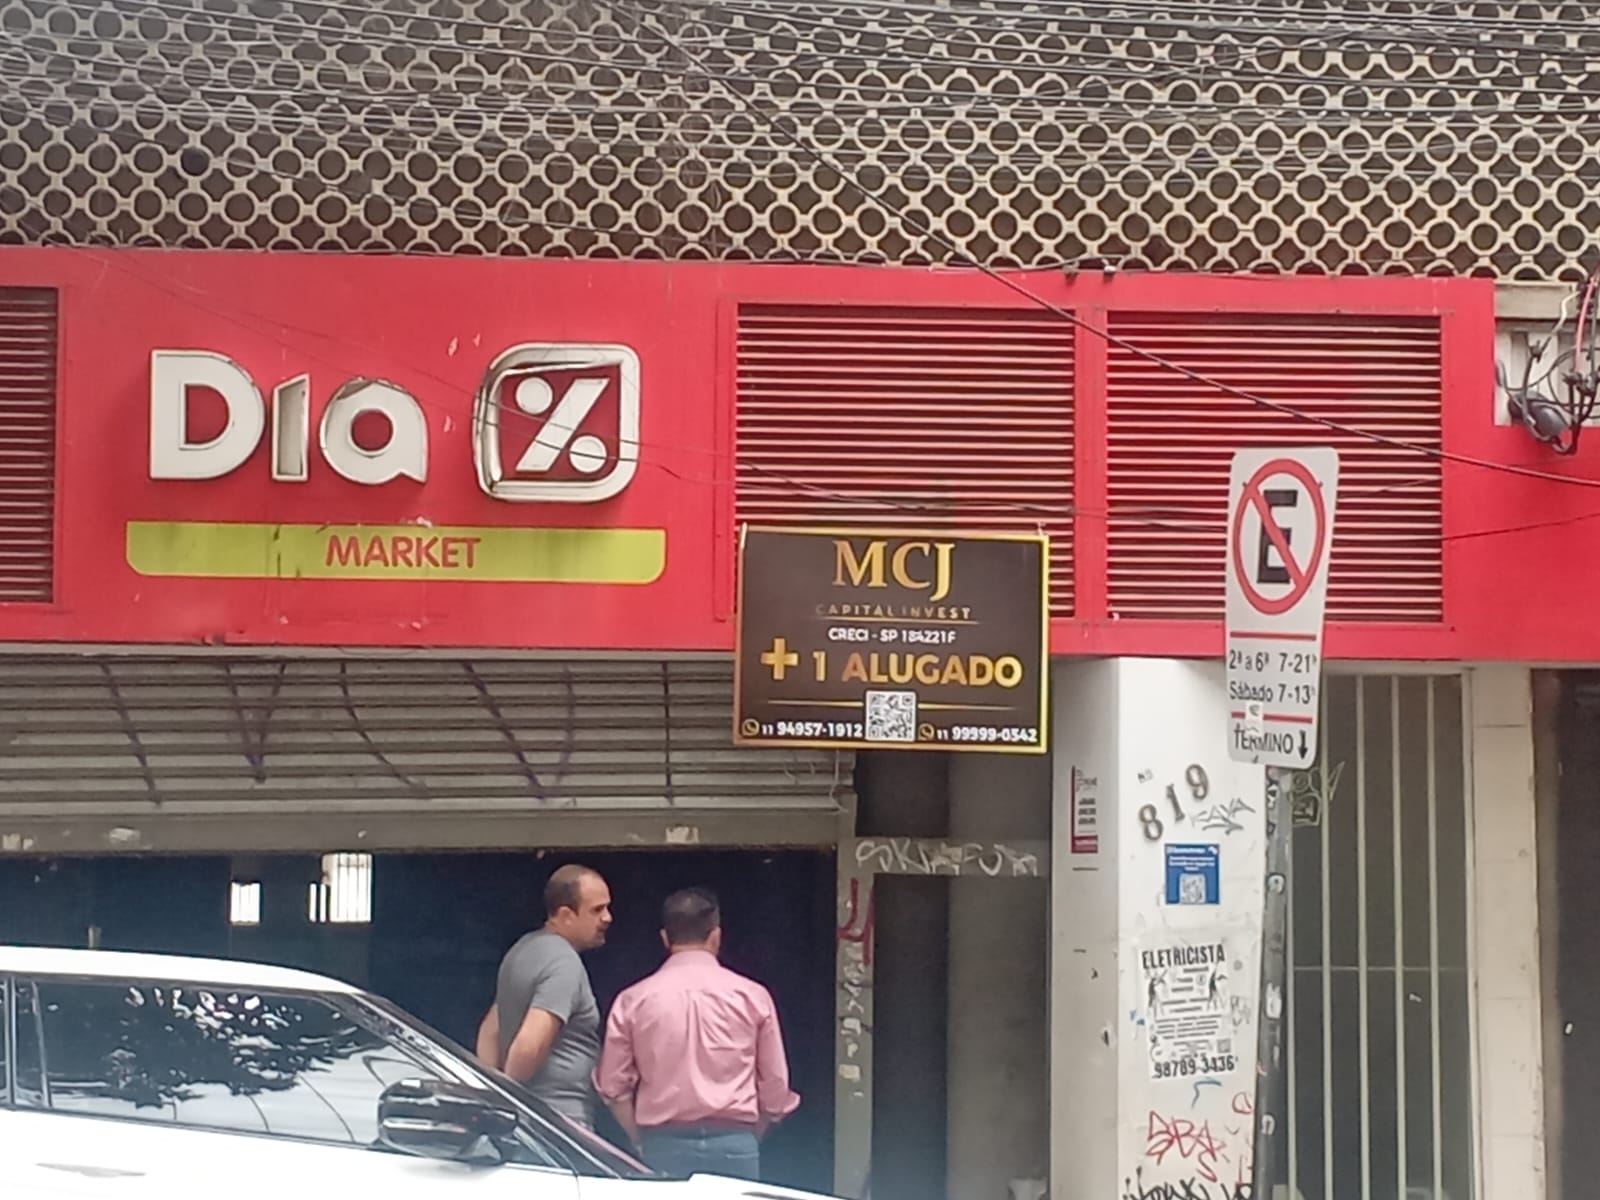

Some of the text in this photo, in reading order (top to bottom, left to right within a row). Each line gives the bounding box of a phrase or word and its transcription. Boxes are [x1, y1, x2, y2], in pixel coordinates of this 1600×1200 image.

[325, 534, 482, 569] MARKET
[832, 540, 955, 602] MCJ
[815, 603, 971, 620] CAPITAL INVEST
[828, 627, 869, 642] CRECI
[880, 628, 899, 643] SP
[812, 650, 827, 681] 1
[841, 652, 1023, 689] ALUGADO
[1245, 655, 1253, 671] a
[777, 721, 863, 738] 94957-1912
[1142, 943, 1226, 970] ELETRICISTA
